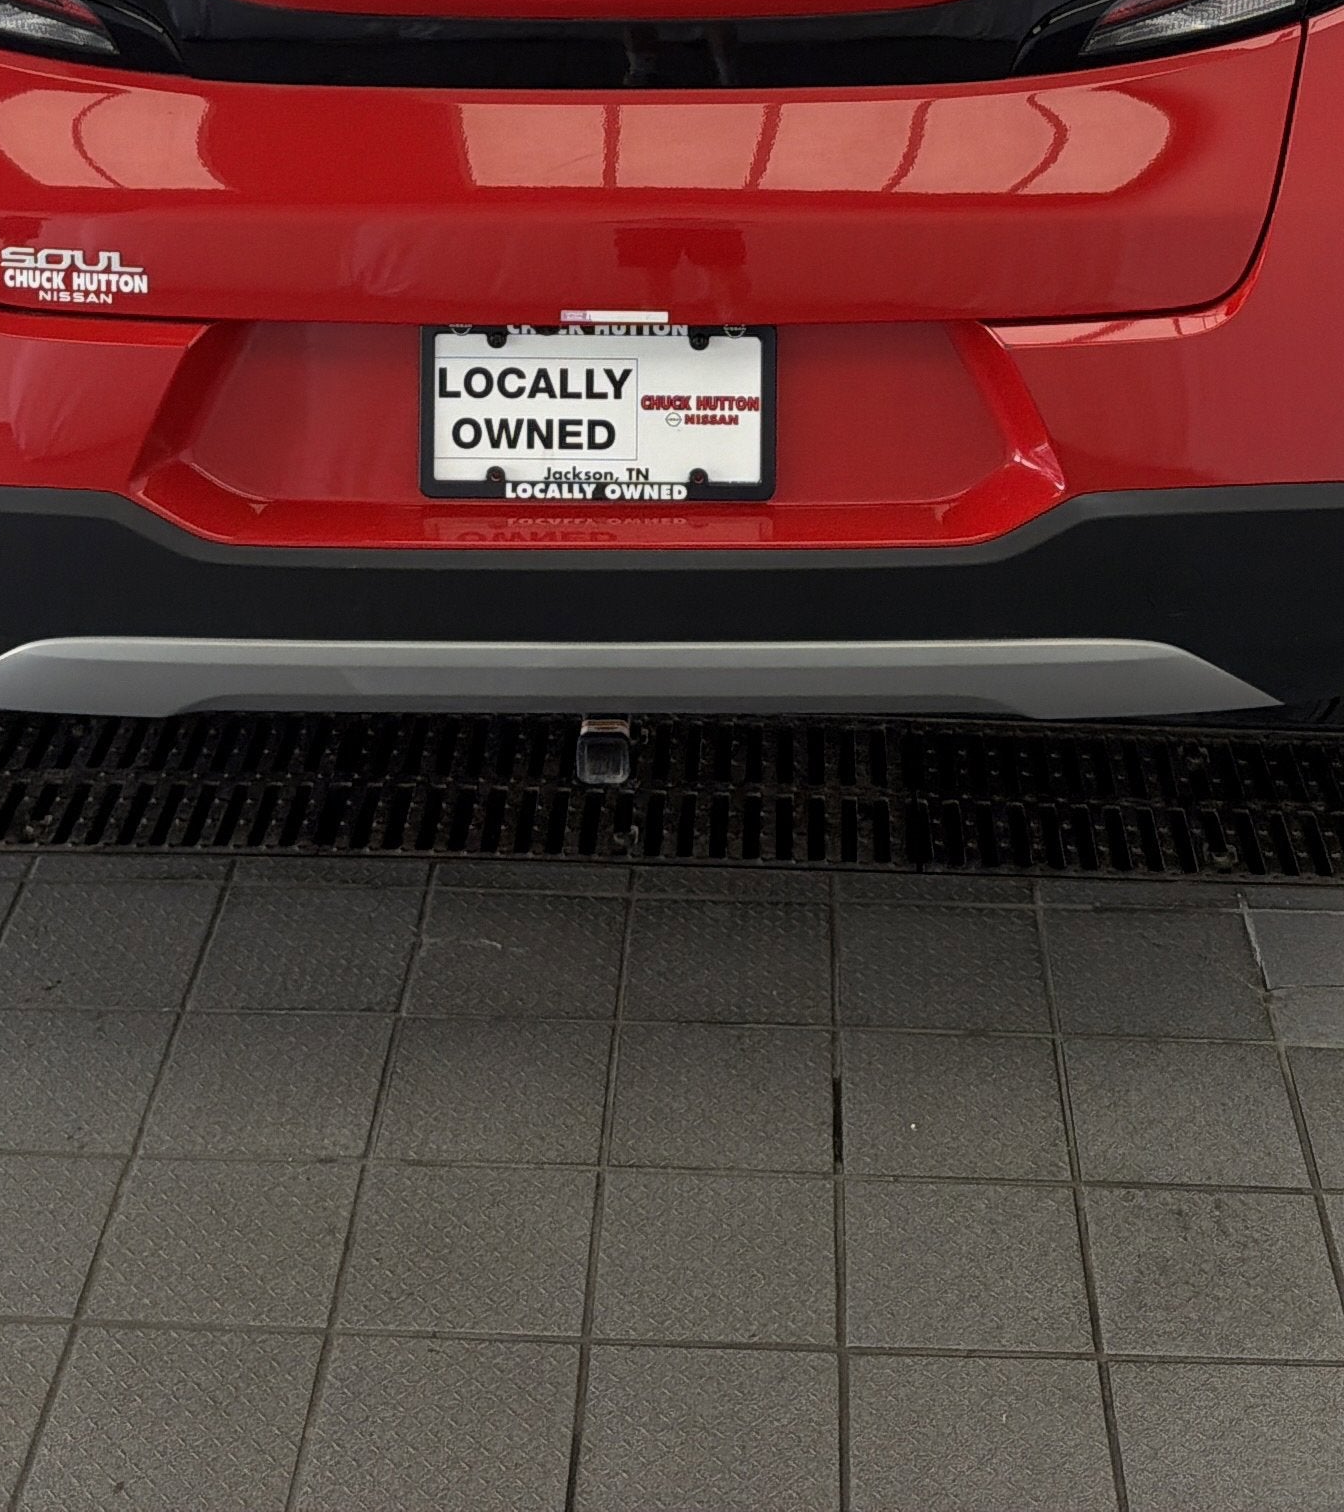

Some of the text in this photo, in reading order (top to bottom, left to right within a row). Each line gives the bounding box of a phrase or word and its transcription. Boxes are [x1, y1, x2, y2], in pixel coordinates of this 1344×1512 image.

[0, 246, 144, 273] SOUL
[4, 268, 149, 294] CHUCK HUTTON
[38, 290, 113, 304] NISSAN
[438, 366, 633, 400] LOCALLY
[640, 394, 760, 412] CHUCK HUTTON
[684, 413, 739, 426] NISSAN
[451, 417, 616, 451] OWNED
[544, 466, 649, 482] Jackson, TN
[505, 482, 688, 500] LOCALLY OWNED
